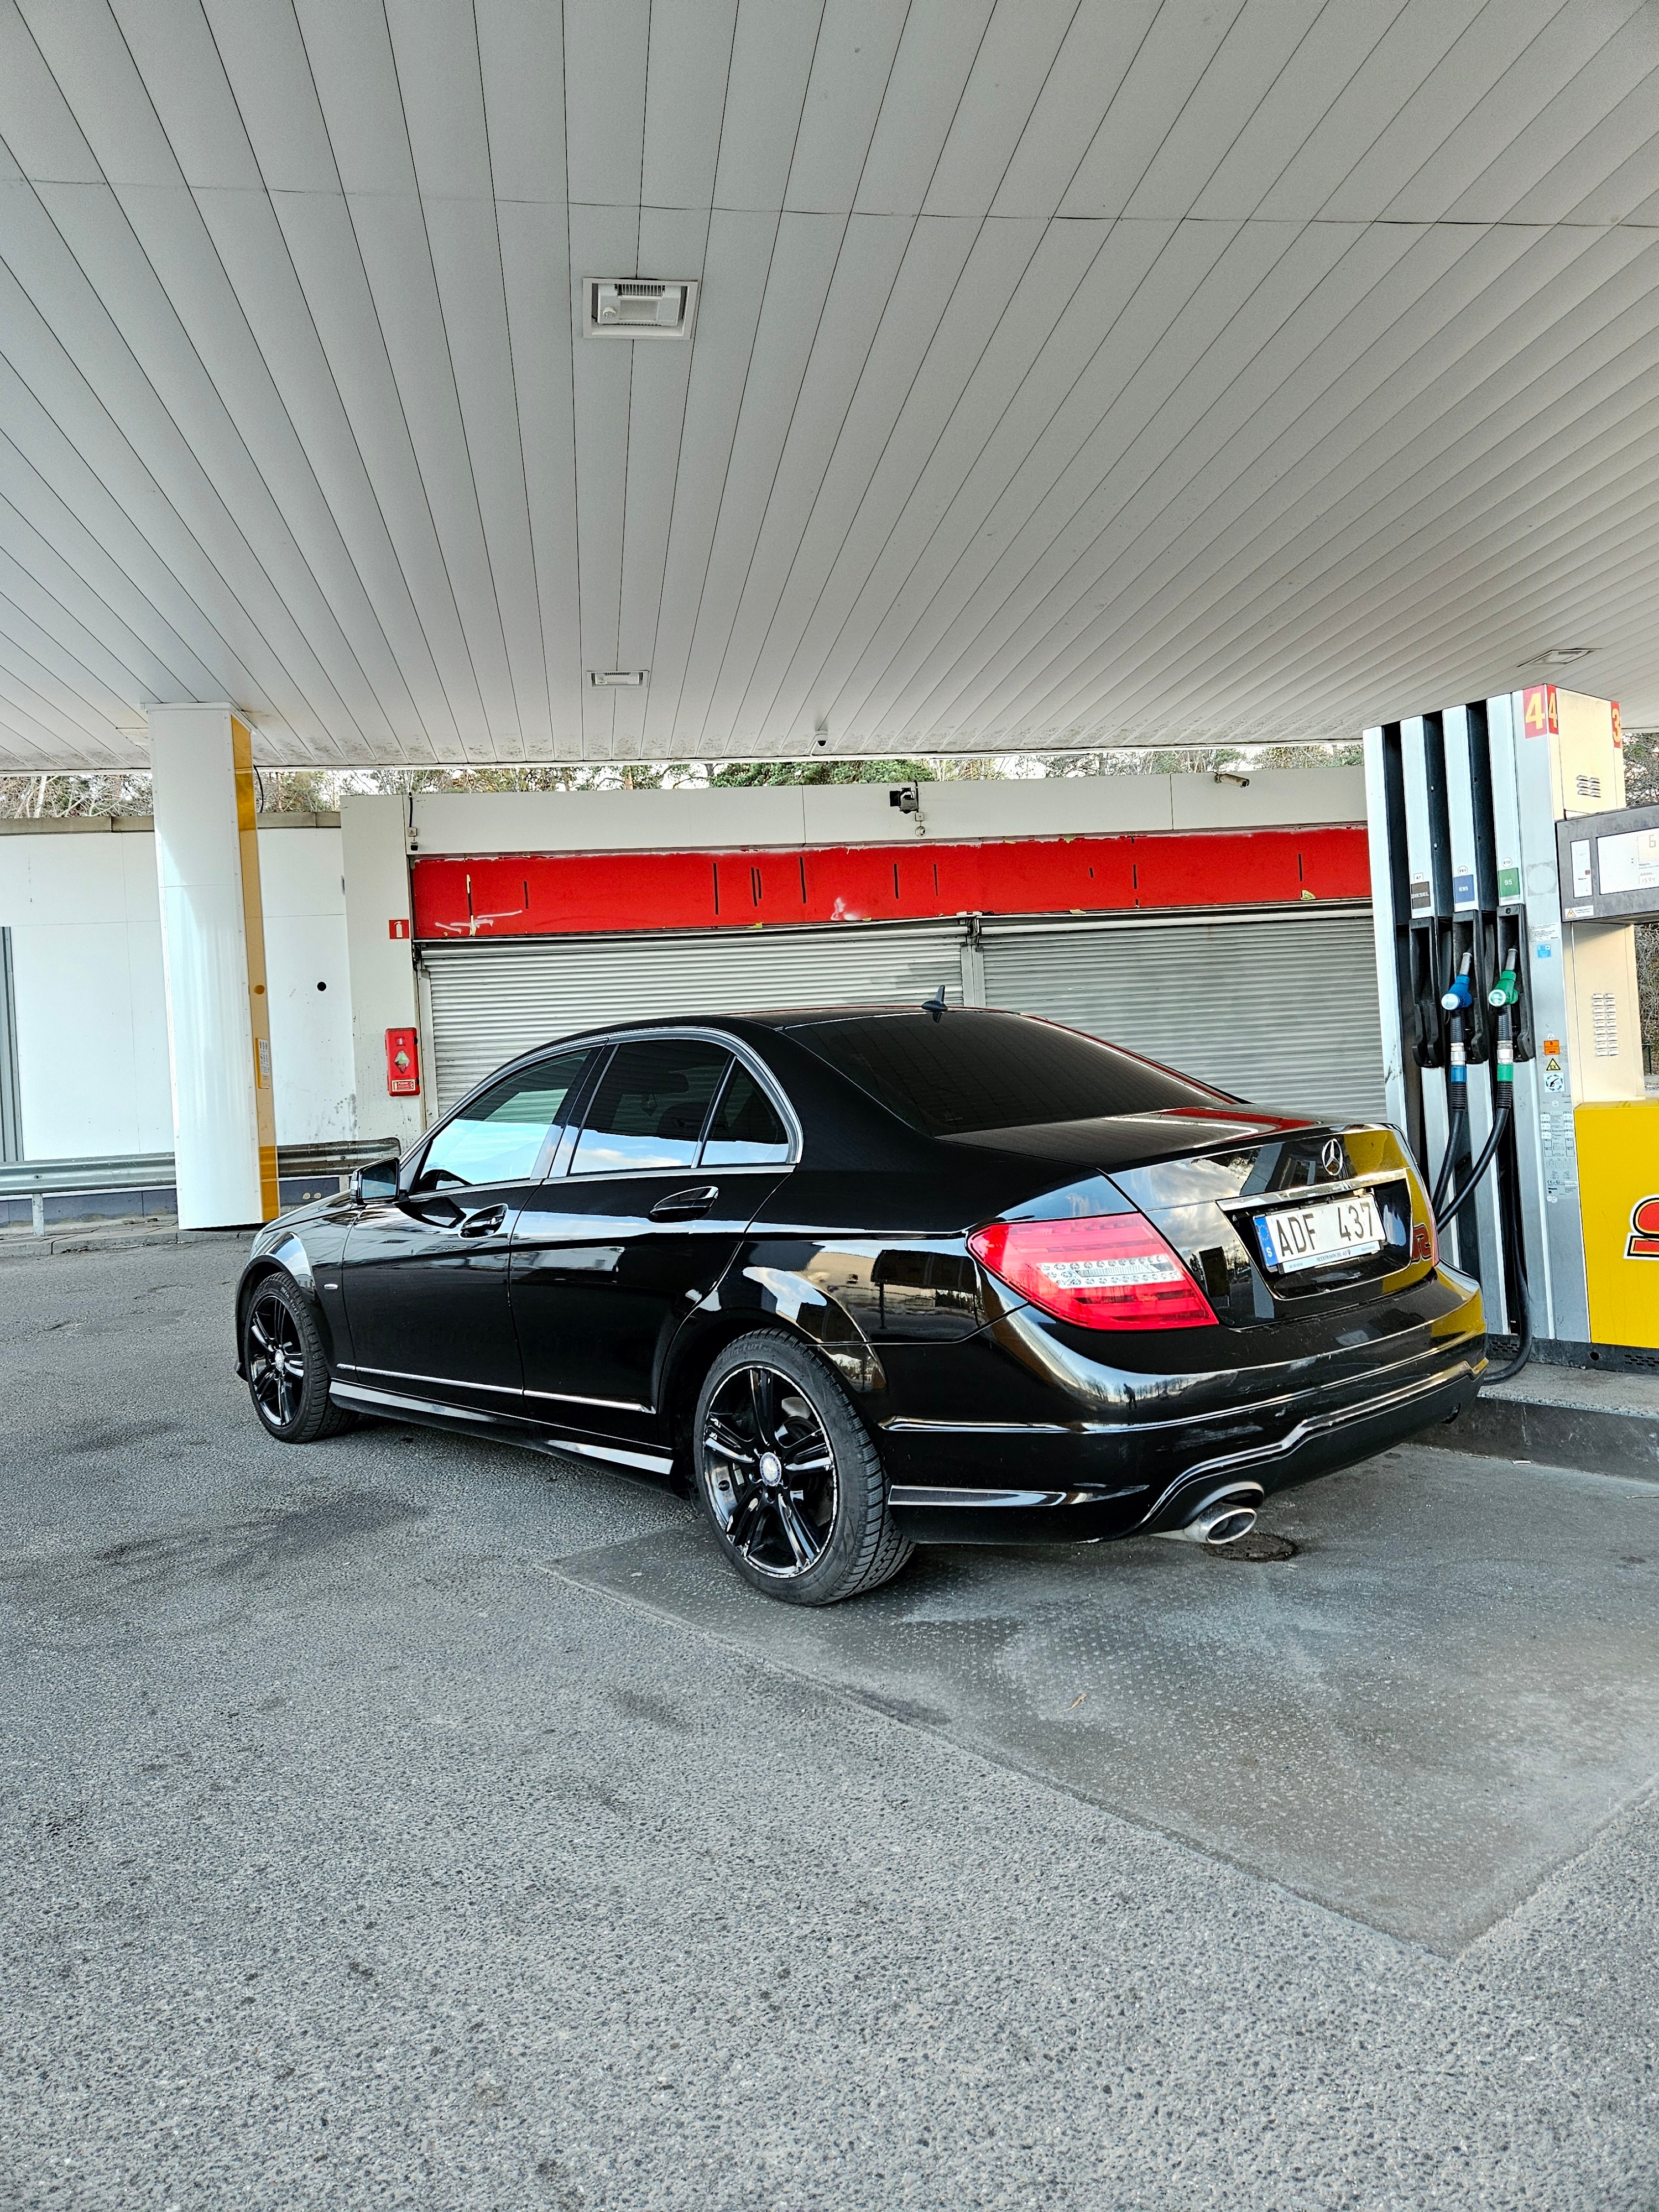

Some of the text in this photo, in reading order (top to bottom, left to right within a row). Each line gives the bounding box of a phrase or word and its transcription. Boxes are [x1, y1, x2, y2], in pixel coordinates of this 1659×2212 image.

[1525, 692, 1545, 730] 4
[1548, 692, 1558, 728] 4
[1612, 708, 1621, 743] 3
[1276, 1201, 1373, 1257] ADF 437
[1266, 1246, 1272, 1258] S
